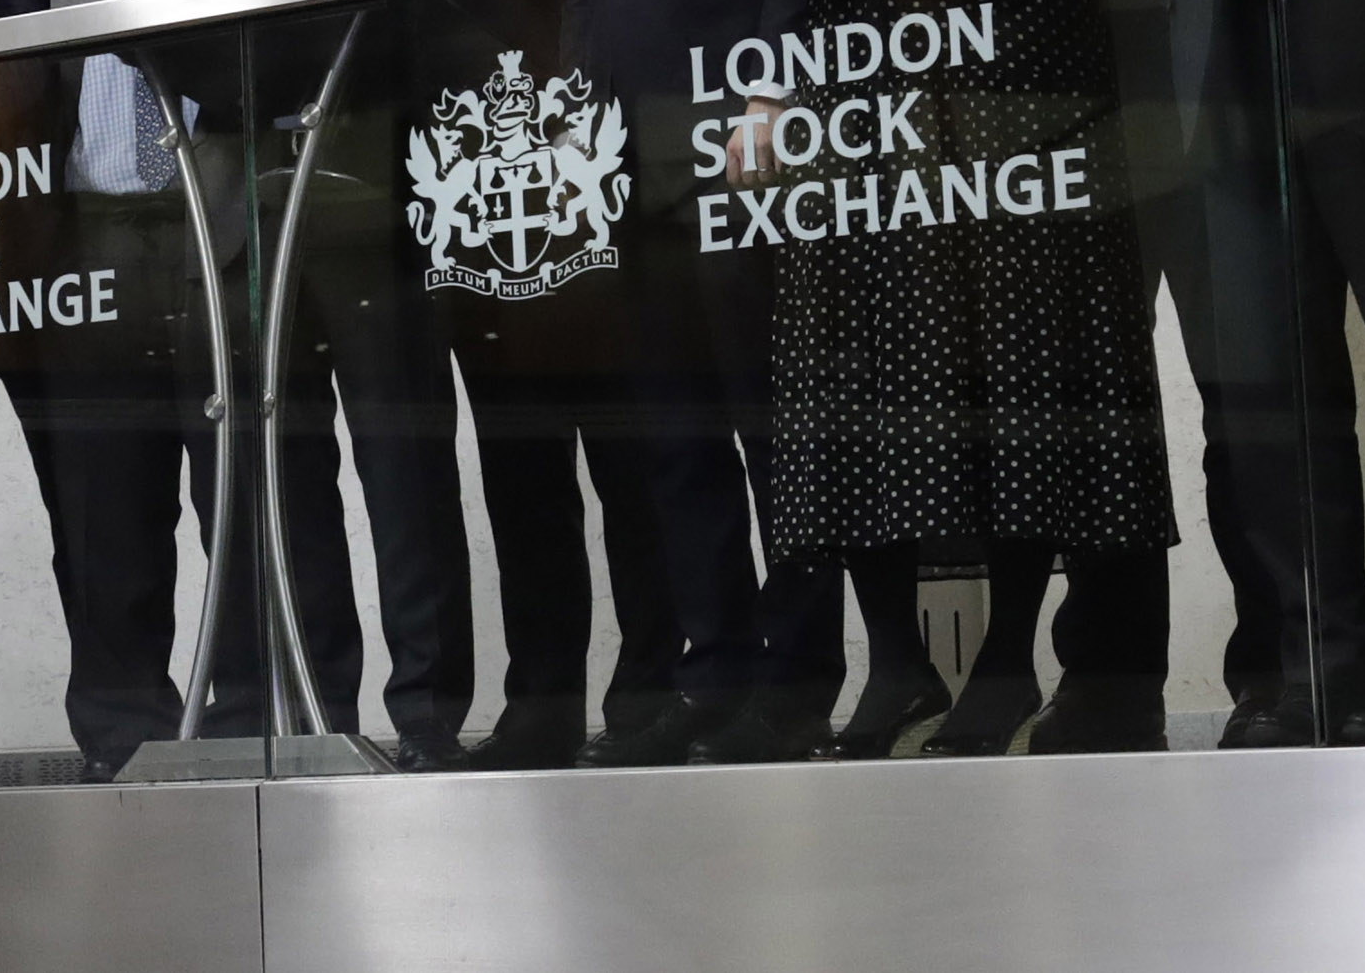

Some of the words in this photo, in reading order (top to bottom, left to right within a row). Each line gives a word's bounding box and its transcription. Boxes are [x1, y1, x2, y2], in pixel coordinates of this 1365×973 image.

[688, 1, 997, 105] LONDON
[689, 90, 926, 179] STOCK
[695, 147, 1092, 254] EXCHANGE
[431, 269, 486, 290] DICTUM
[501, 281, 540, 296] MEUM
[555, 251, 613, 281] PACTUM
